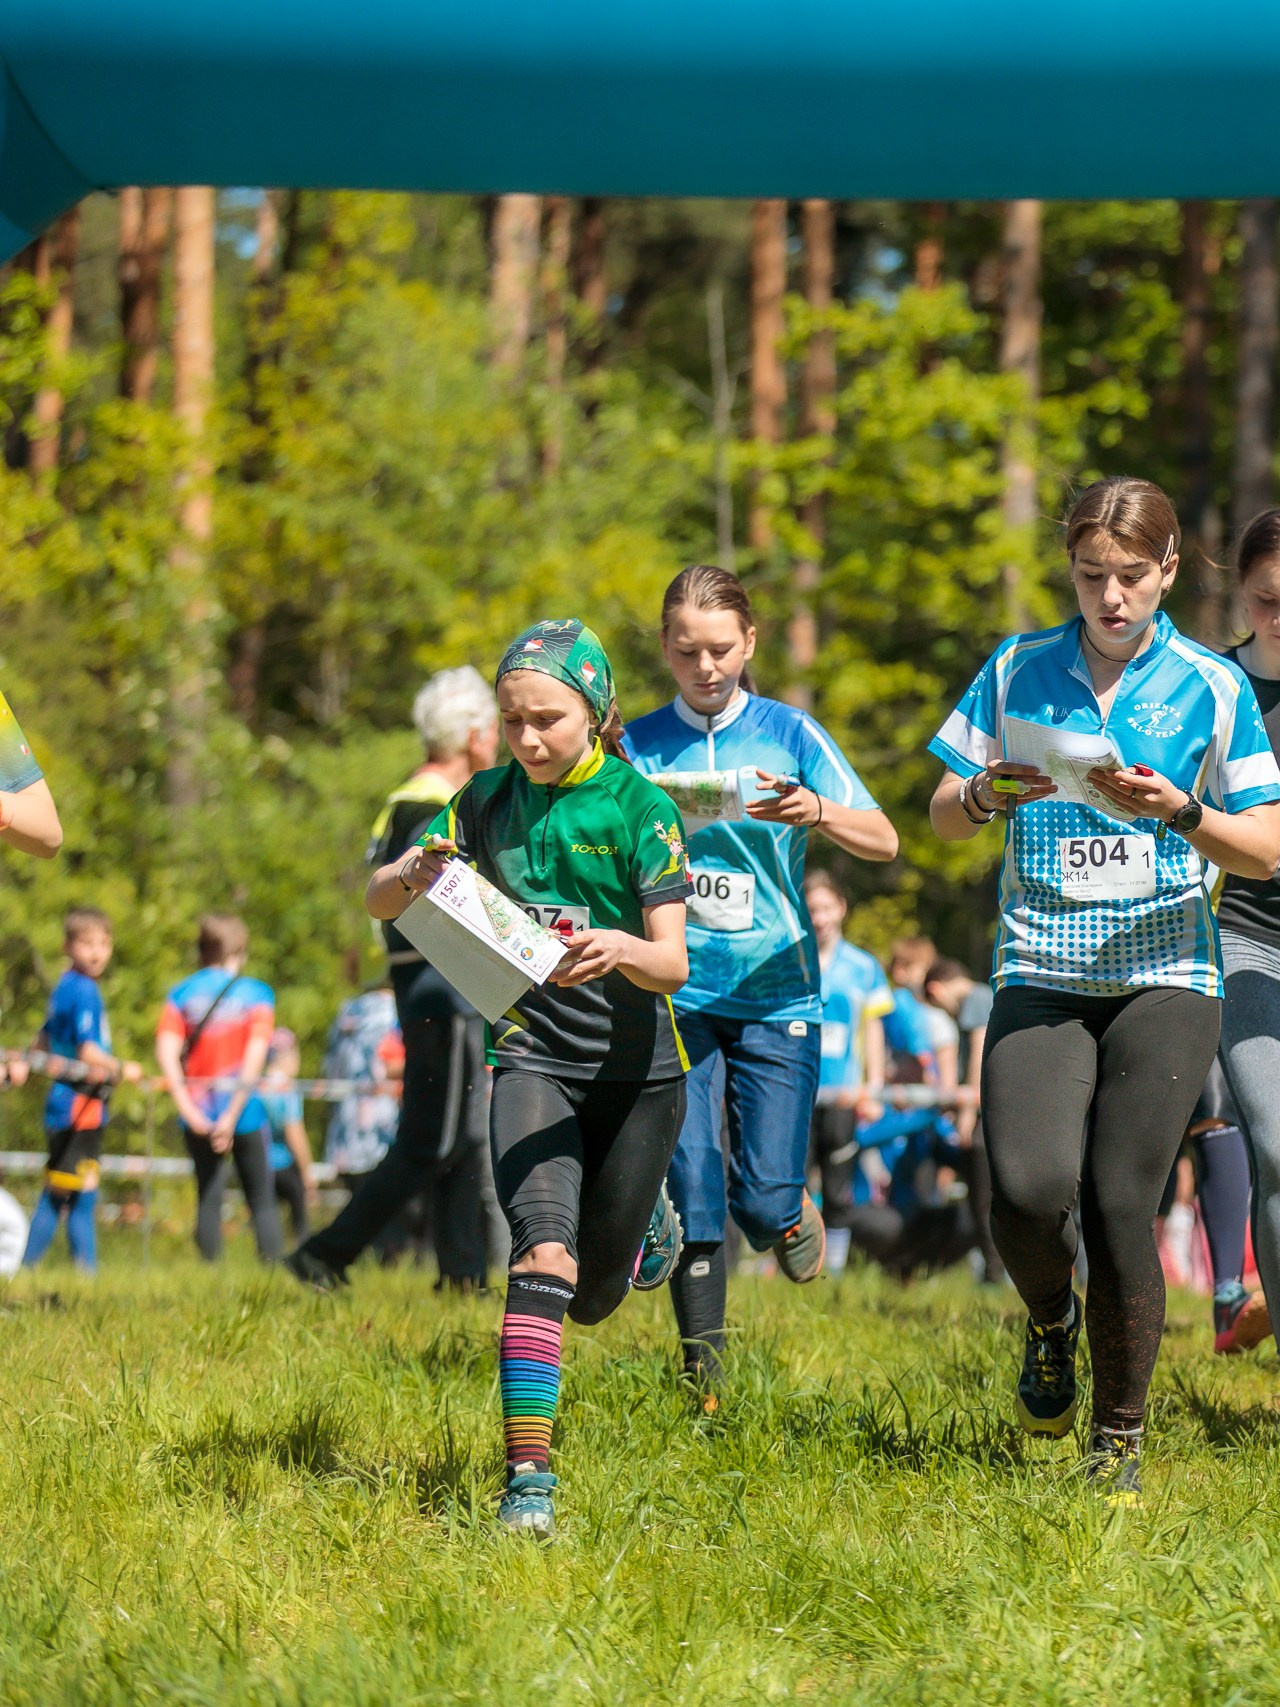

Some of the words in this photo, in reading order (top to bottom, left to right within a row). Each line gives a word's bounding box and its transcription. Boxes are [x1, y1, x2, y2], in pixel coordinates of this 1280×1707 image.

[1133, 702, 1181, 718] ORIENTA
[1127, 717, 1152, 736] SKI-O
[1155, 724, 1184, 738] TEAM
[571, 843, 619, 855] FOTON
[1068, 838, 1129, 868] 504
[1142, 850, 1150, 869] 1
[693, 873, 731, 900] 06
[1061, 871, 1089, 882] Ж14
[518, 903, 563, 930] 07
